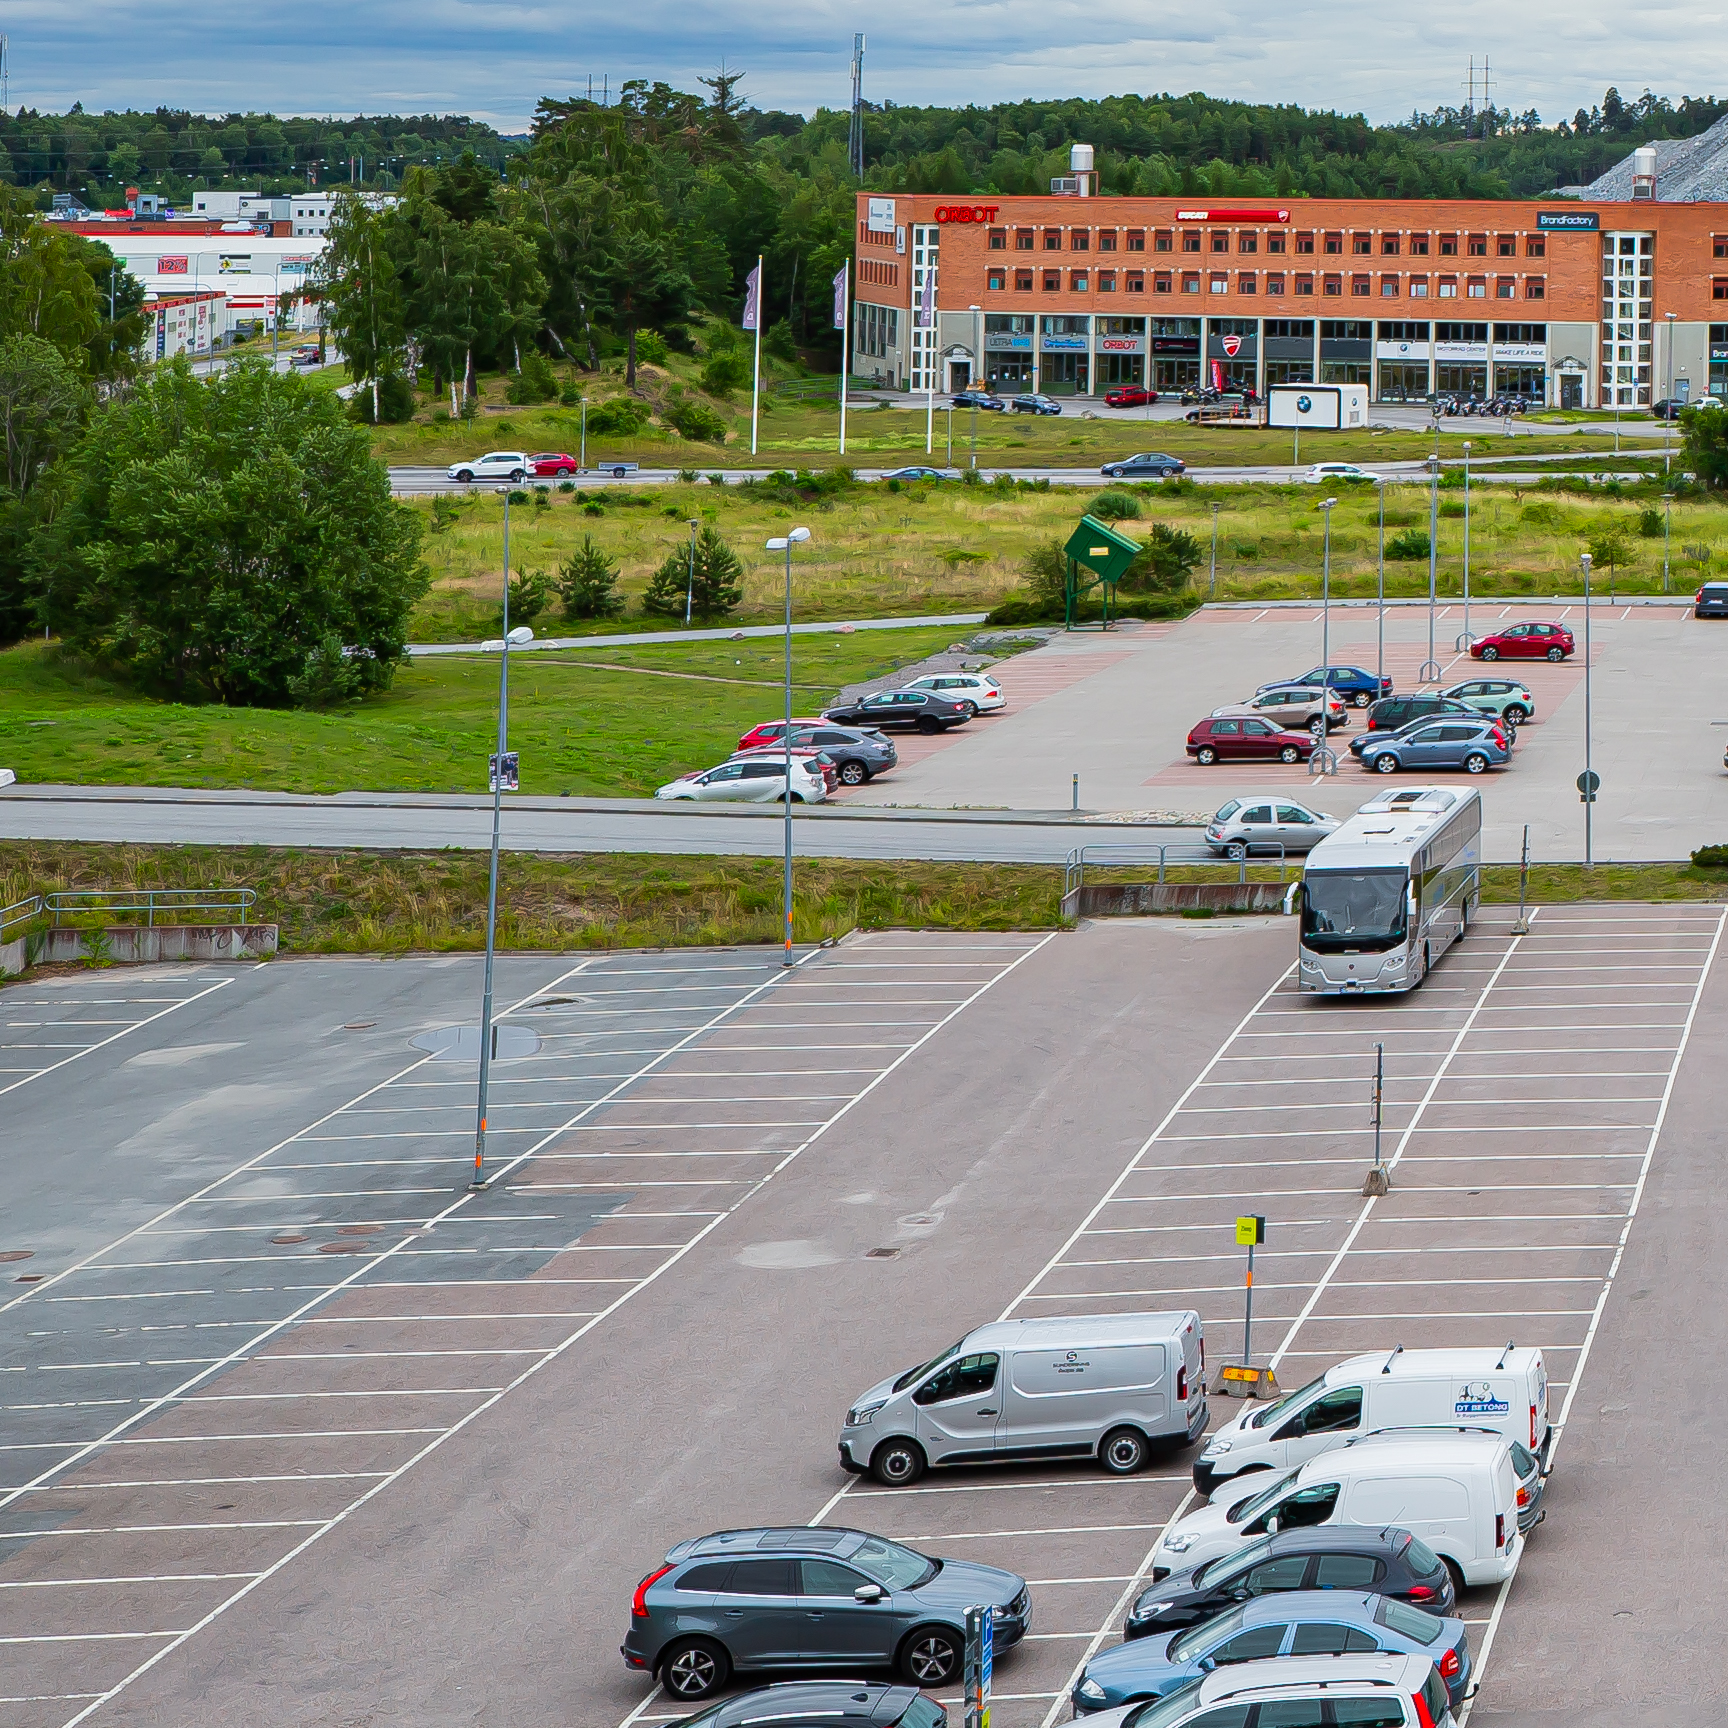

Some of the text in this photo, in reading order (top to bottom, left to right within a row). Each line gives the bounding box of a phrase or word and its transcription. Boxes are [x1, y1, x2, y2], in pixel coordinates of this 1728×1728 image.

[934, 206, 999, 223] ORBOT
[1540, 215, 1594, 226] BrandFactory
[1456, 1403, 1508, 1412] DT BETONG
